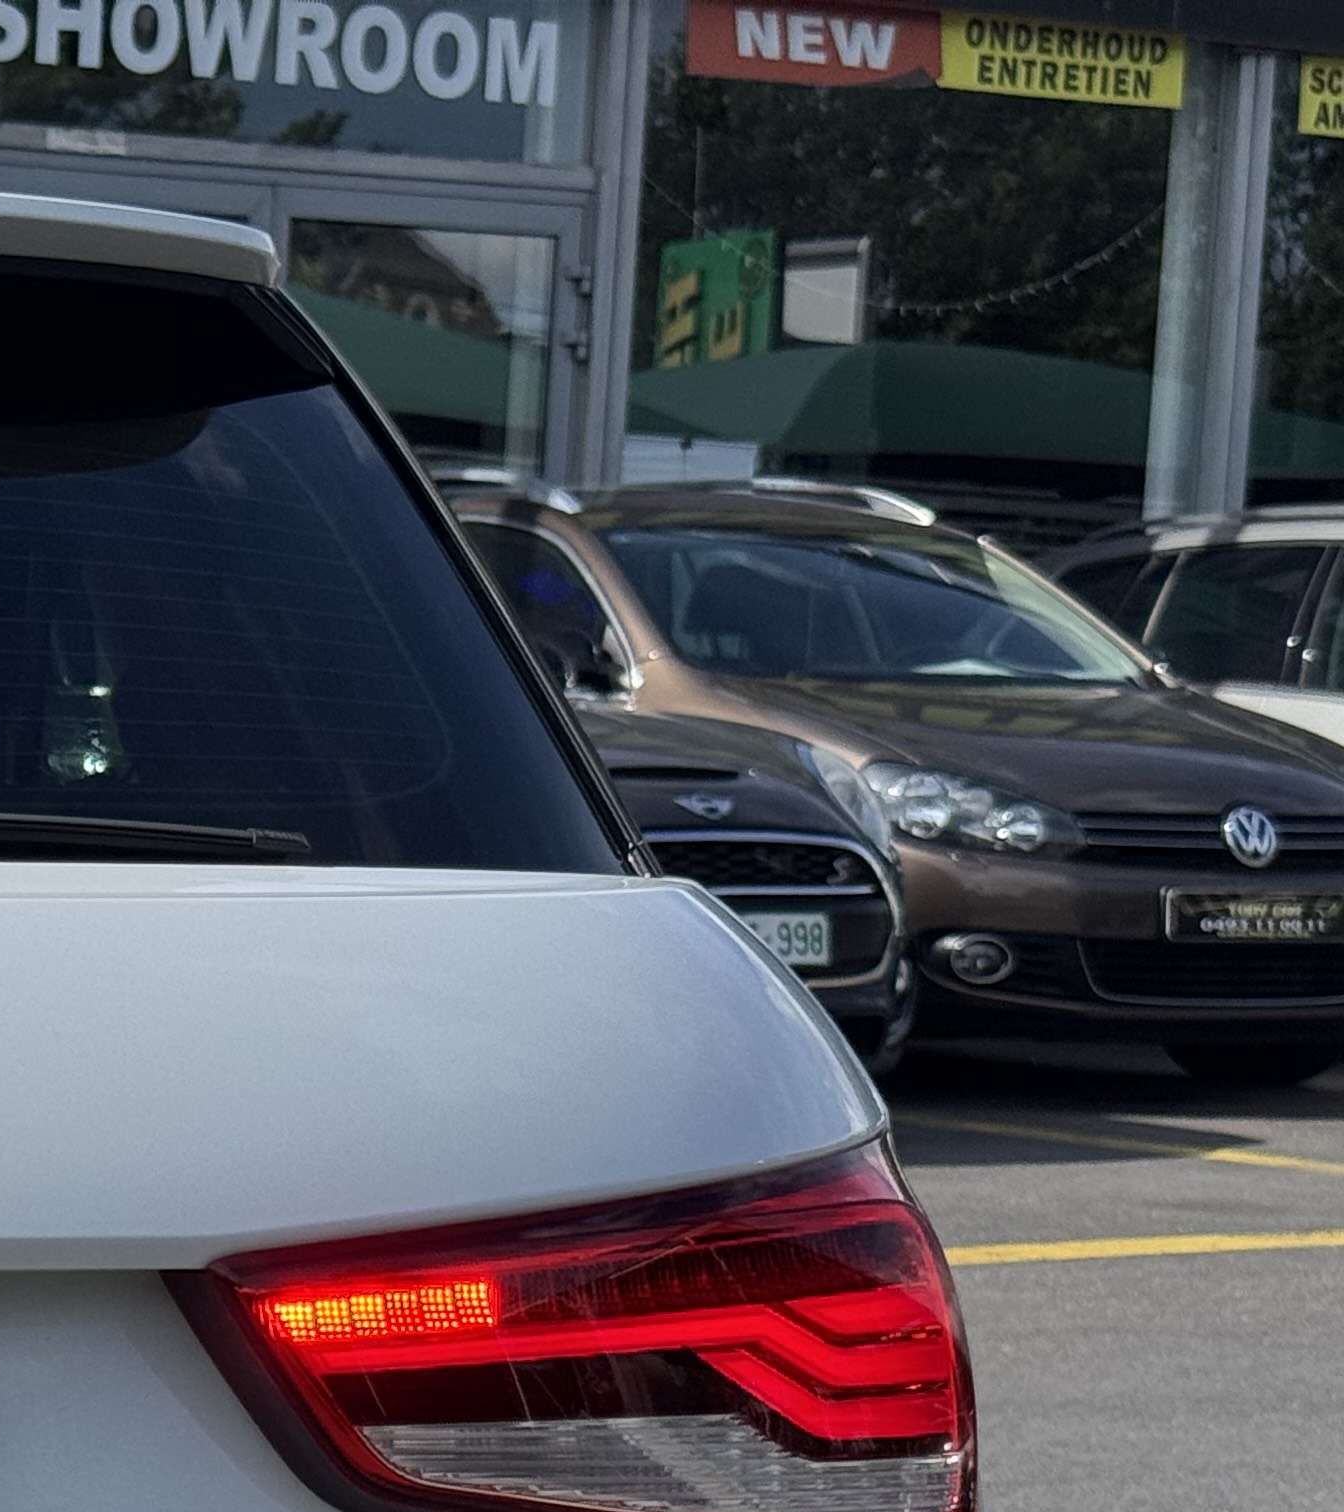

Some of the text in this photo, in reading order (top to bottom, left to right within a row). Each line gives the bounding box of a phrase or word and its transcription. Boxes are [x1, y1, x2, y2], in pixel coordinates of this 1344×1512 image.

[735, 9, 896, 71] NEW
[964, 17, 1169, 66] ONDERHOUD
[976, 54, 1153, 99] ENTRETIEN
